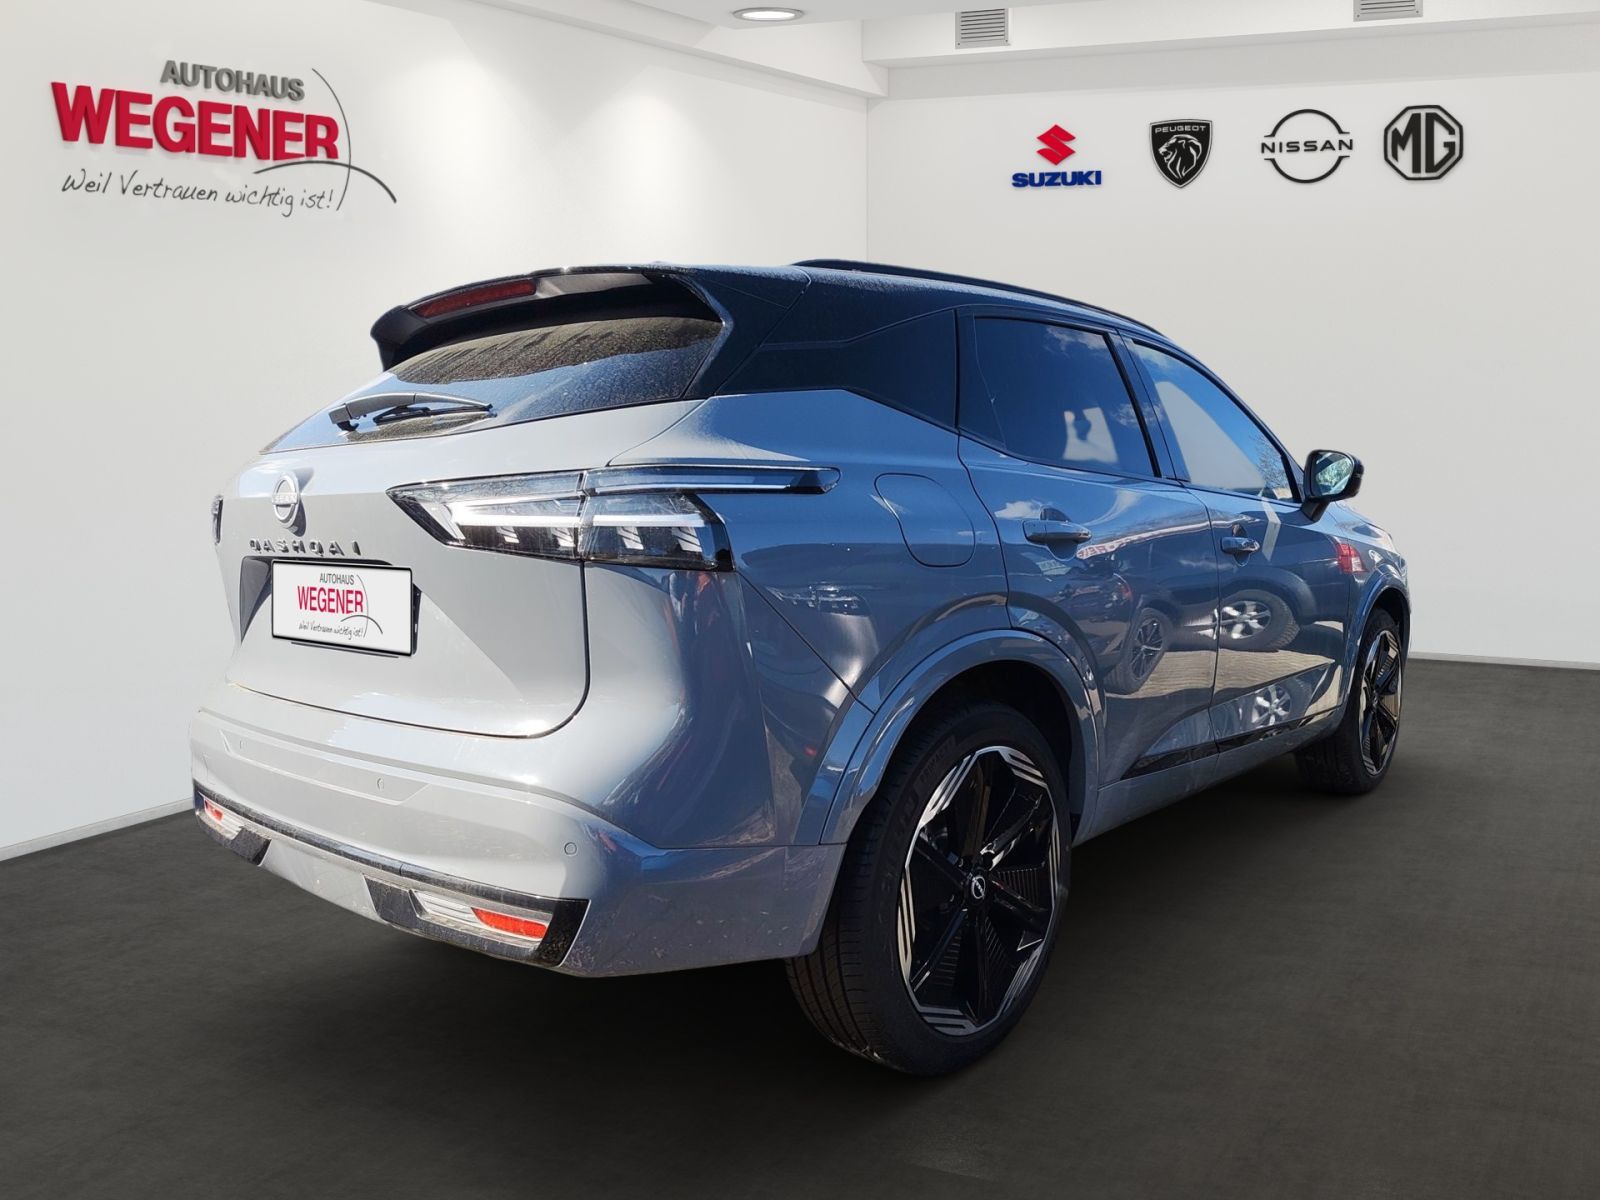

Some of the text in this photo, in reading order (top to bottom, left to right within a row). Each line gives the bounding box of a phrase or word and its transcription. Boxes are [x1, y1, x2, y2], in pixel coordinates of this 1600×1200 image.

[160, 60, 304, 101] AUTOHAUS
[51, 81, 339, 161] WEGENER
[1154, 125, 1207, 134] PEUGEOT
[1261, 138, 1353, 154] NISSAN
[1391, 112, 1456, 174] MG
[1011, 170, 1102, 188] SUZUKI
[62, 168, 334, 217] Weil Vertrauen wichtig ist!
[249, 539, 361, 557] QASHQAI
[320, 573, 355, 585] AUTOHAUS
[297, 585, 364, 615] WEGENER
